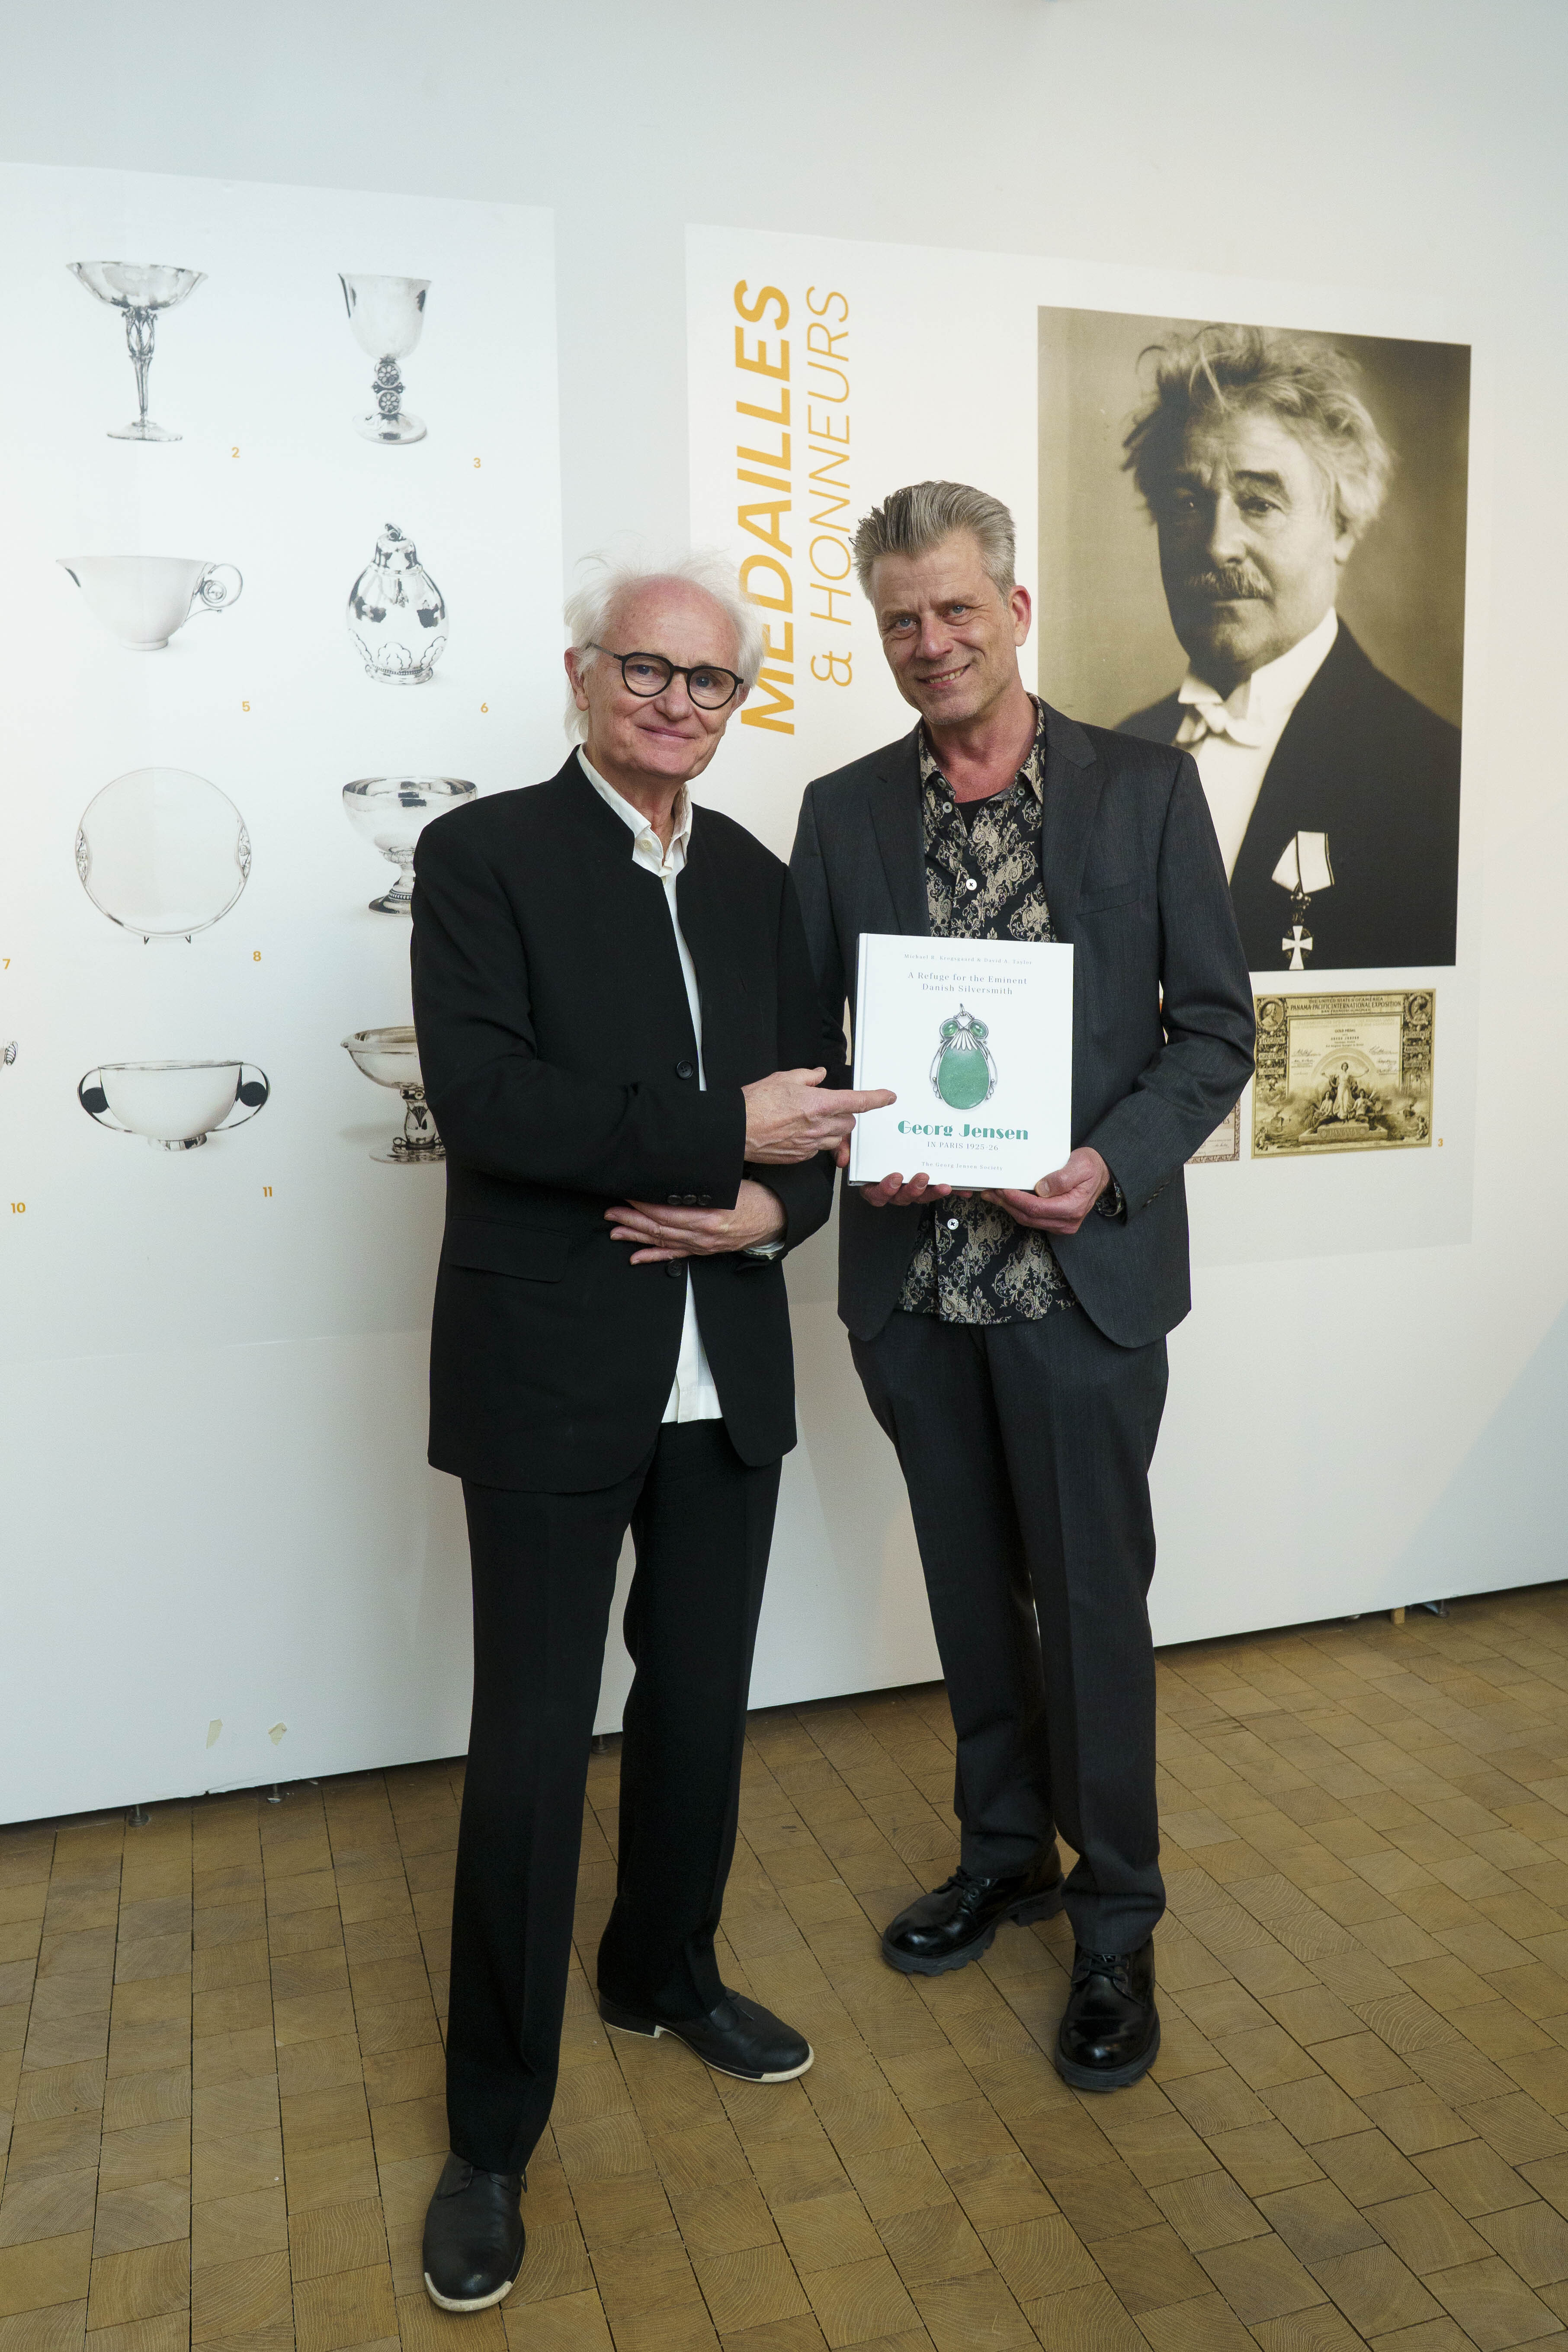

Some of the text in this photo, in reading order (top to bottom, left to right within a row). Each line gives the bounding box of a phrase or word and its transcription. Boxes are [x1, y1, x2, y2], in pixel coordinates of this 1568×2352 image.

[232, 447, 240, 458] 2
[474, 457, 481, 468] 3
[806, 286, 853, 687] & HONNEURS
[733, 279, 795, 736] MEDAILLES
[242, 701, 250, 712] 5
[481, 702, 488, 713] 6
[253, 951, 261, 961] 8
[3, 958, 11, 969] 7
[918, 972, 949, 982] Refuge
[953, 973, 966, 981] for
[988, 975, 1027, 984] Eminent
[922, 983, 1013, 995] Danish Silversmith
[1331, 1002, 1371, 1010] INTERNATIONAL
[898, 1120, 1029, 1140] Georg Jensen
[1438, 1138, 1443, 1147] 3
[263, 1186, 273, 1197] 11
[10, 1202, 26, 1214] 10
